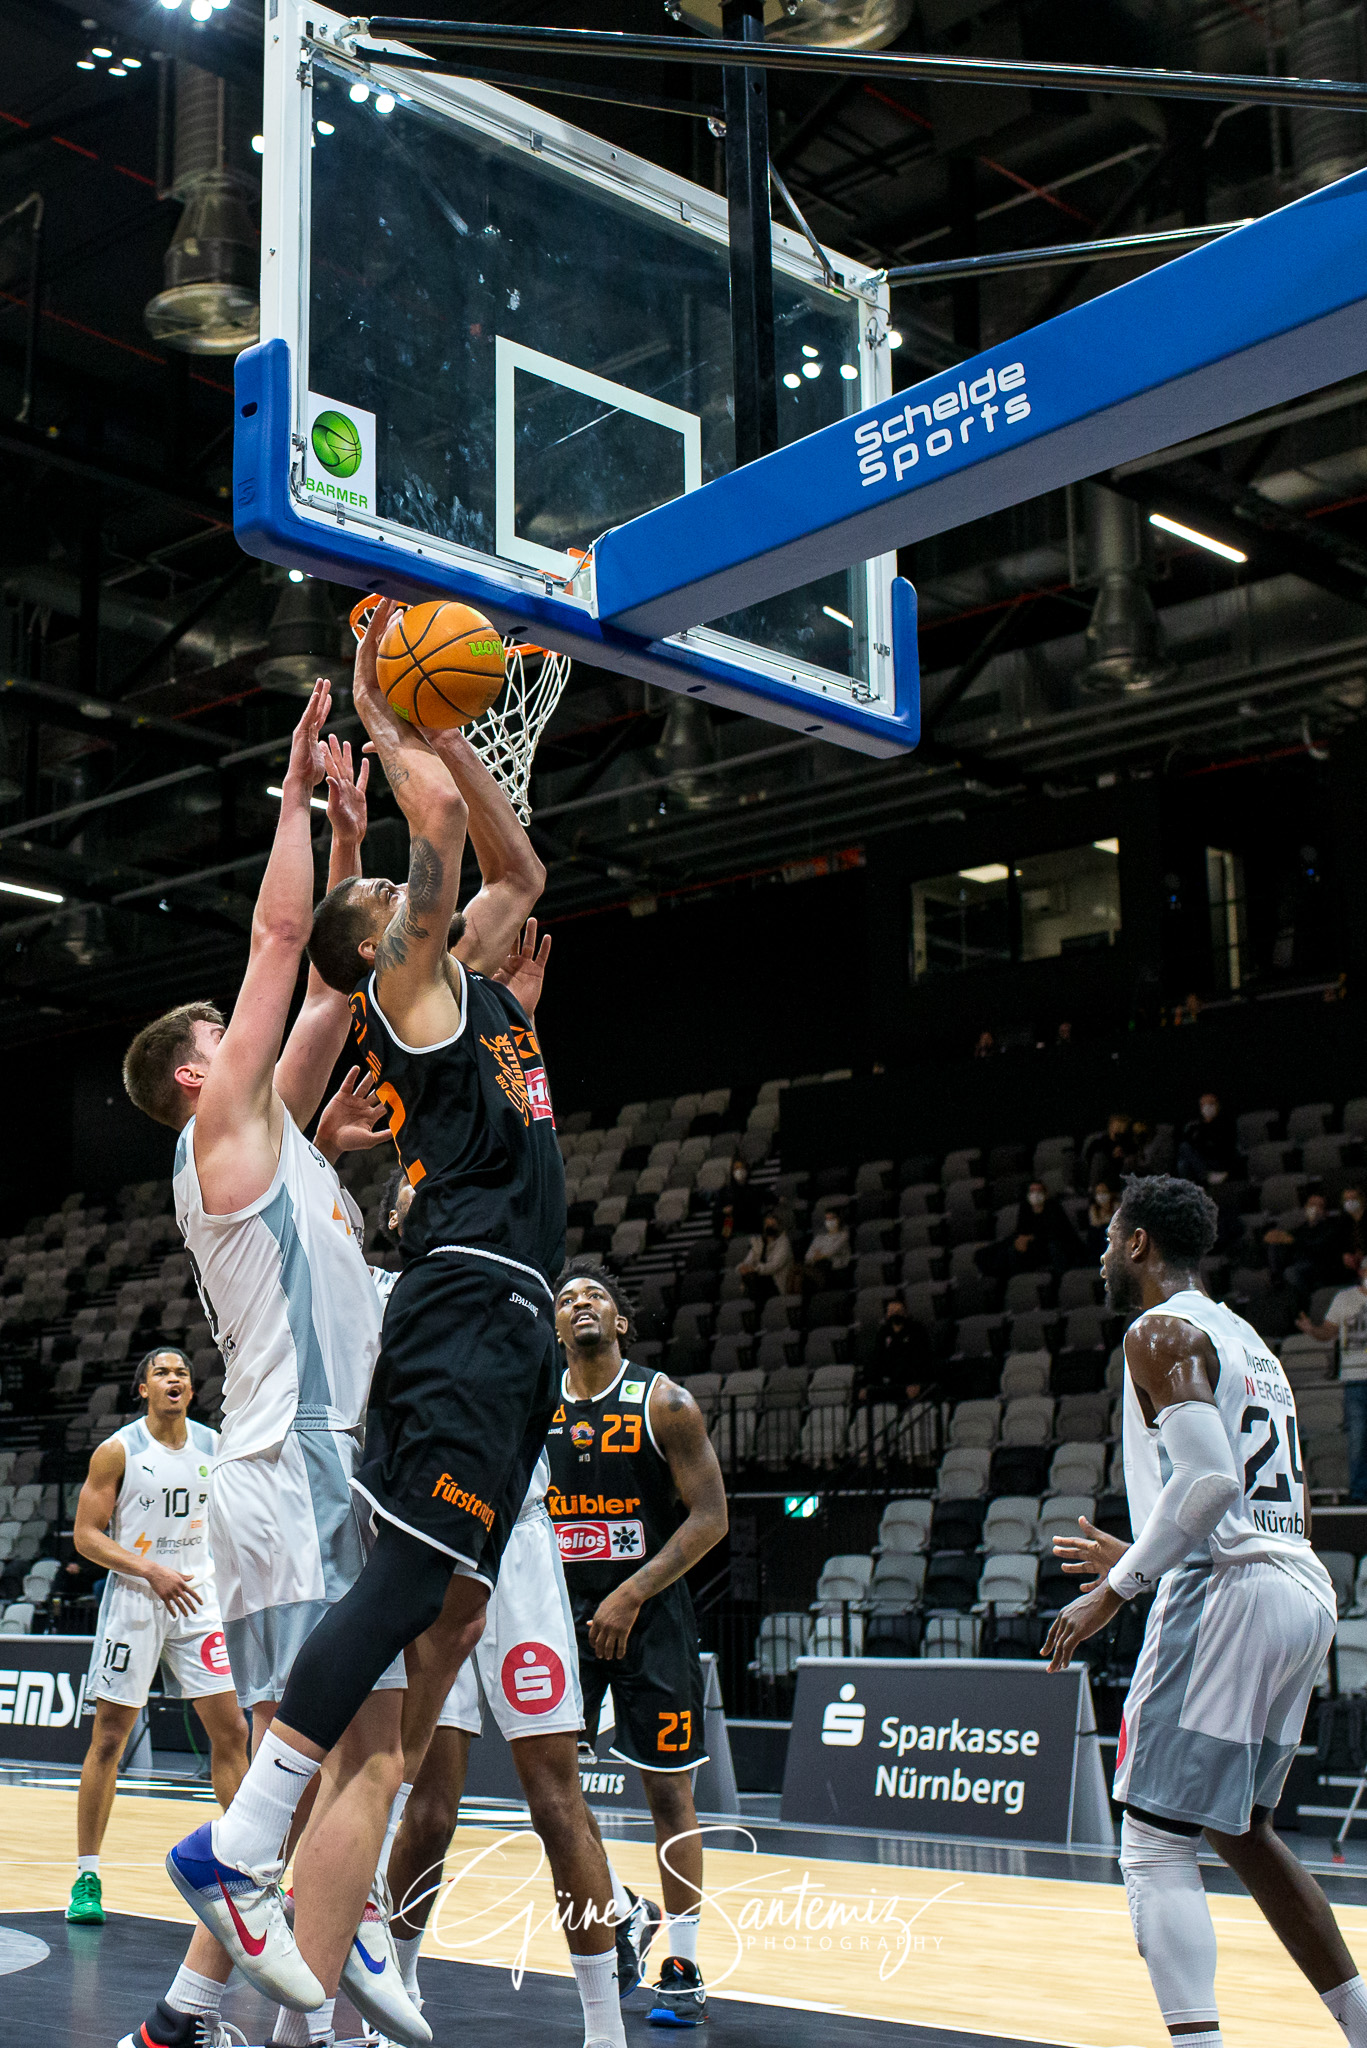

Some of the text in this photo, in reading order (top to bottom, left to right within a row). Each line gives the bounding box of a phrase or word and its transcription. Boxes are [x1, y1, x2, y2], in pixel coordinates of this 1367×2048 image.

[855, 362, 1026, 457] Schelde
[859, 393, 1031, 487] Sports
[305, 478, 368, 509] BARMER
[601, 1413, 642, 1453] 23
[162, 1487, 190, 1518] 10
[548, 1494, 641, 1516] Kübler
[557, 1532, 607, 1549] Helios
[104, 1638, 132, 1673] 10
[657, 1710, 692, 1752] 23
[878, 1716, 1040, 1757] Sparkasse
[875, 1764, 1026, 1815] Nürnberg
